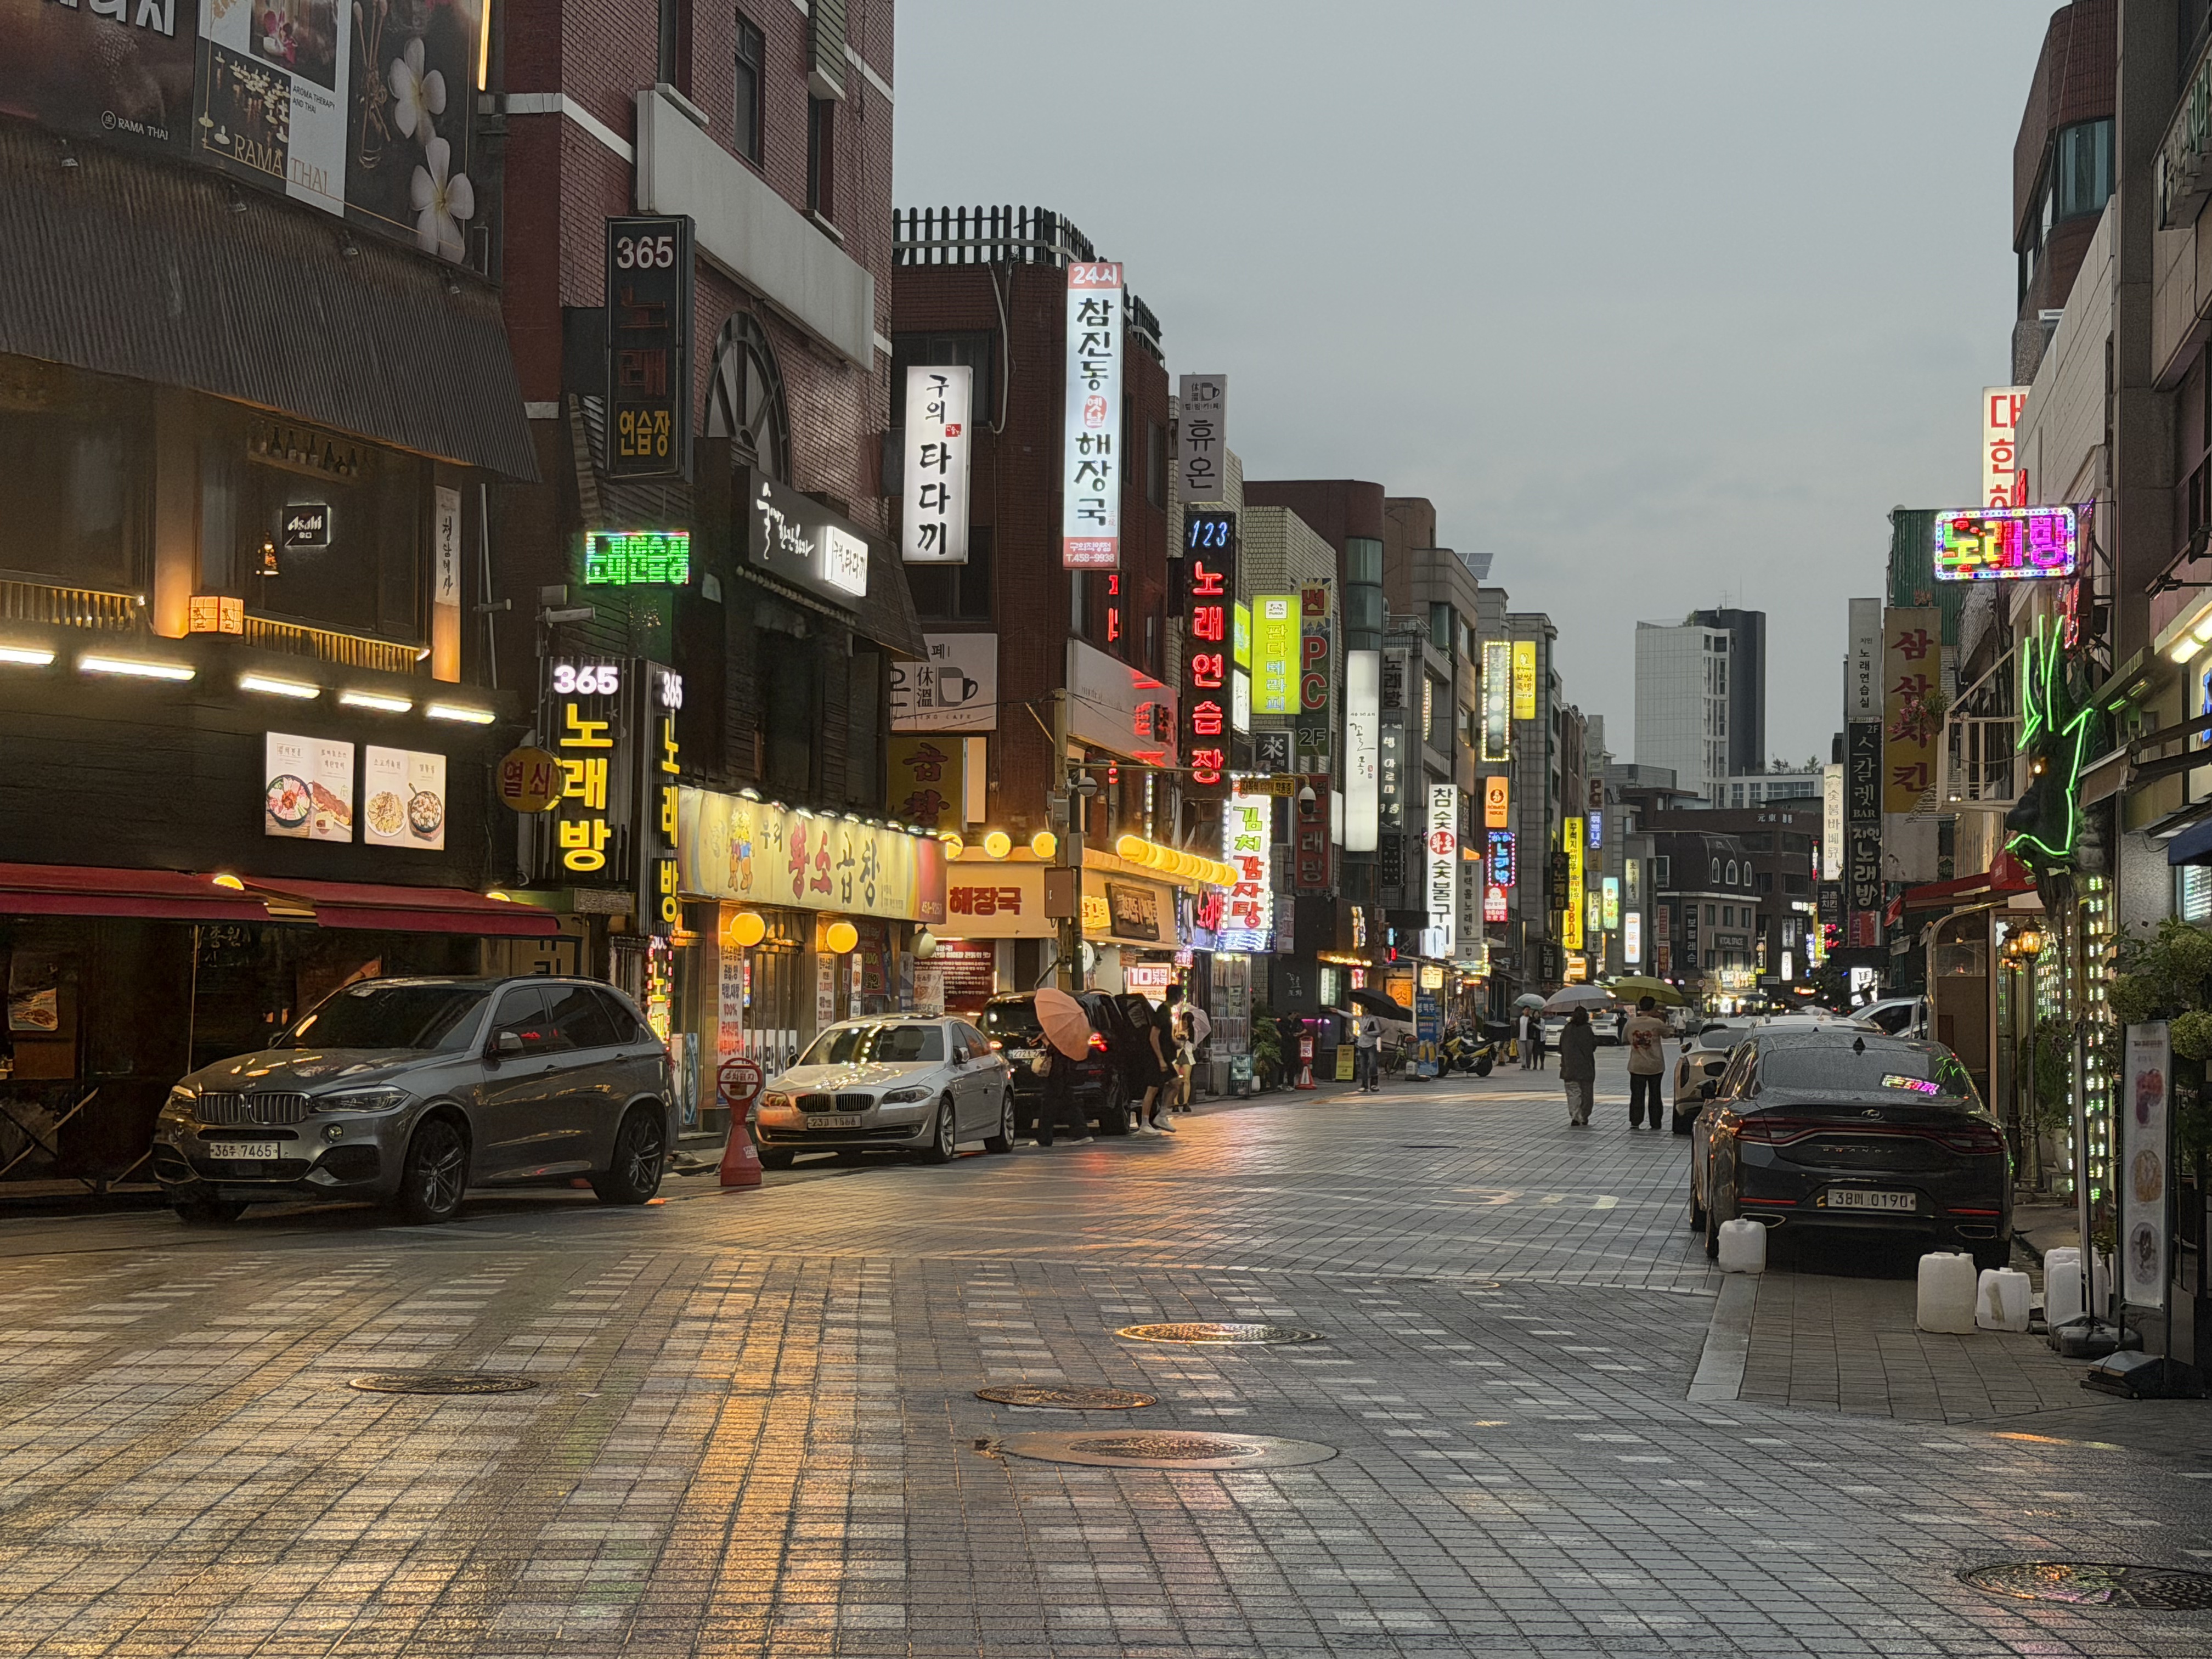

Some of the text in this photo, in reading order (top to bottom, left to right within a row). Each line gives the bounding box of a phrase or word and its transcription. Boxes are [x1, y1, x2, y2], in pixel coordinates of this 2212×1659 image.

[292, 84, 312, 99] AROMA
[292, 97, 304, 108] AND
[118, 117, 168, 140] RAMA THAI
[234, 133, 327, 194] RAMA THAI
[617, 236, 674, 269] 365
[1073, 265, 1118, 286] 24시
[618, 285, 668, 396] 노래
[1076, 297, 1114, 391] 참진동
[925, 374, 950, 425] 구의
[1086, 396, 1105, 427] 옛날
[619, 410, 670, 457] 연습장
[1185, 419, 1216, 489] 휴온
[1074, 432, 1113, 526] 해장국
[917, 442, 952, 555] 타다끼
[287, 515, 322, 531] Asahi
[1191, 520, 1228, 548] 123
[1069, 541, 1111, 552] 구의직영점
[1942, 517, 2068, 568] 노래방
[1301, 588, 1325, 617] 썬
[1266, 624, 1288, 657] 판다
[553, 665, 618, 695] 365
[1191, 560, 1224, 785] 노래연습장
[1301, 635, 1328, 710] PC
[1383, 655, 1402, 707] 노래방
[1859, 648, 1871, 709] 노래연습실
[661, 671, 682, 710] 365
[1298, 727, 1326, 747] 2F
[1867, 725, 1880, 733] 2F
[1262, 736, 1284, 759] 來
[503, 760, 549, 799] 열쇠
[559, 702, 613, 871] 노래방
[1852, 736, 1877, 806] 스칼렛
[661, 718, 680, 923] 노래방
[1433, 787, 1453, 830] 참숯
[1827, 789, 1841, 859] 숯불바베큐
[1853, 809, 1876, 818] BAR
[1853, 828, 1881, 842] 지인
[1232, 806, 1265, 929] 김치감자탕
[1854, 842, 1878, 906] 노래방
[949, 887, 1022, 916] 해장국
[1821, 890, 1838, 899] 교촌
[1821, 899, 1838, 908] 치킨
[1131, 968, 1167, 985] 10 년전
[1152, 977, 1168, 985] 가격
[240, 1145, 272, 1158] 7465
[1871, 1193, 1909, 1208] 0190
